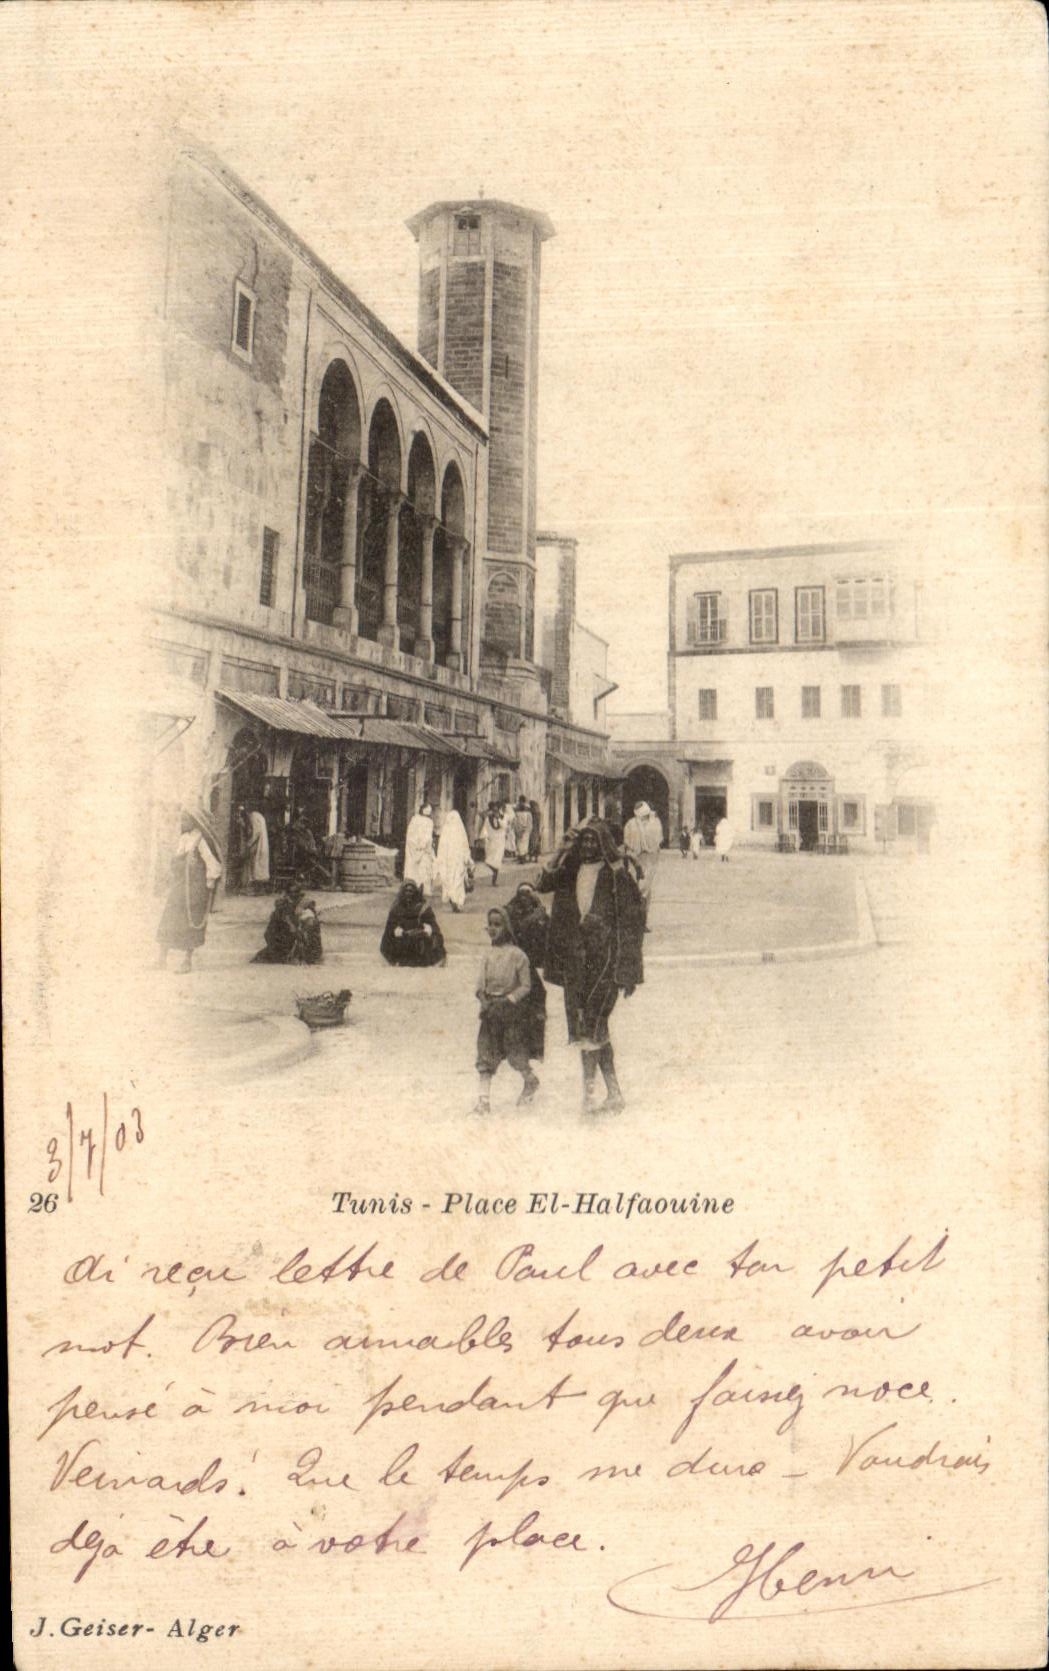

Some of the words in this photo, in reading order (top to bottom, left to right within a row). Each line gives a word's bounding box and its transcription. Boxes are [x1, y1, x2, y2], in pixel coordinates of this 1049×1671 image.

[270, 1241, 395, 1286] lettre
[420, 1253, 467, 1283] de
[496, 1243, 604, 1282] Paul
[613, 1258, 698, 1280] avec
[812, 1226, 950, 1298] petit
[192, 1308, 296, 1353] Bien
[547, 1308, 624, 1352] tous
[182, 1387, 210, 1417] à
[354, 1375, 588, 1434] pendant
[599, 1389, 655, 1432] que
[288, 1447, 359, 1491] Que
[378, 1442, 418, 1486] le
[437, 1444, 548, 1499] temps
[577, 1462, 642, 1482] me
[272, 1523, 303, 1550] à
[310, 1512, 430, 1555] votre
[459, 1510, 606, 1571] place.
